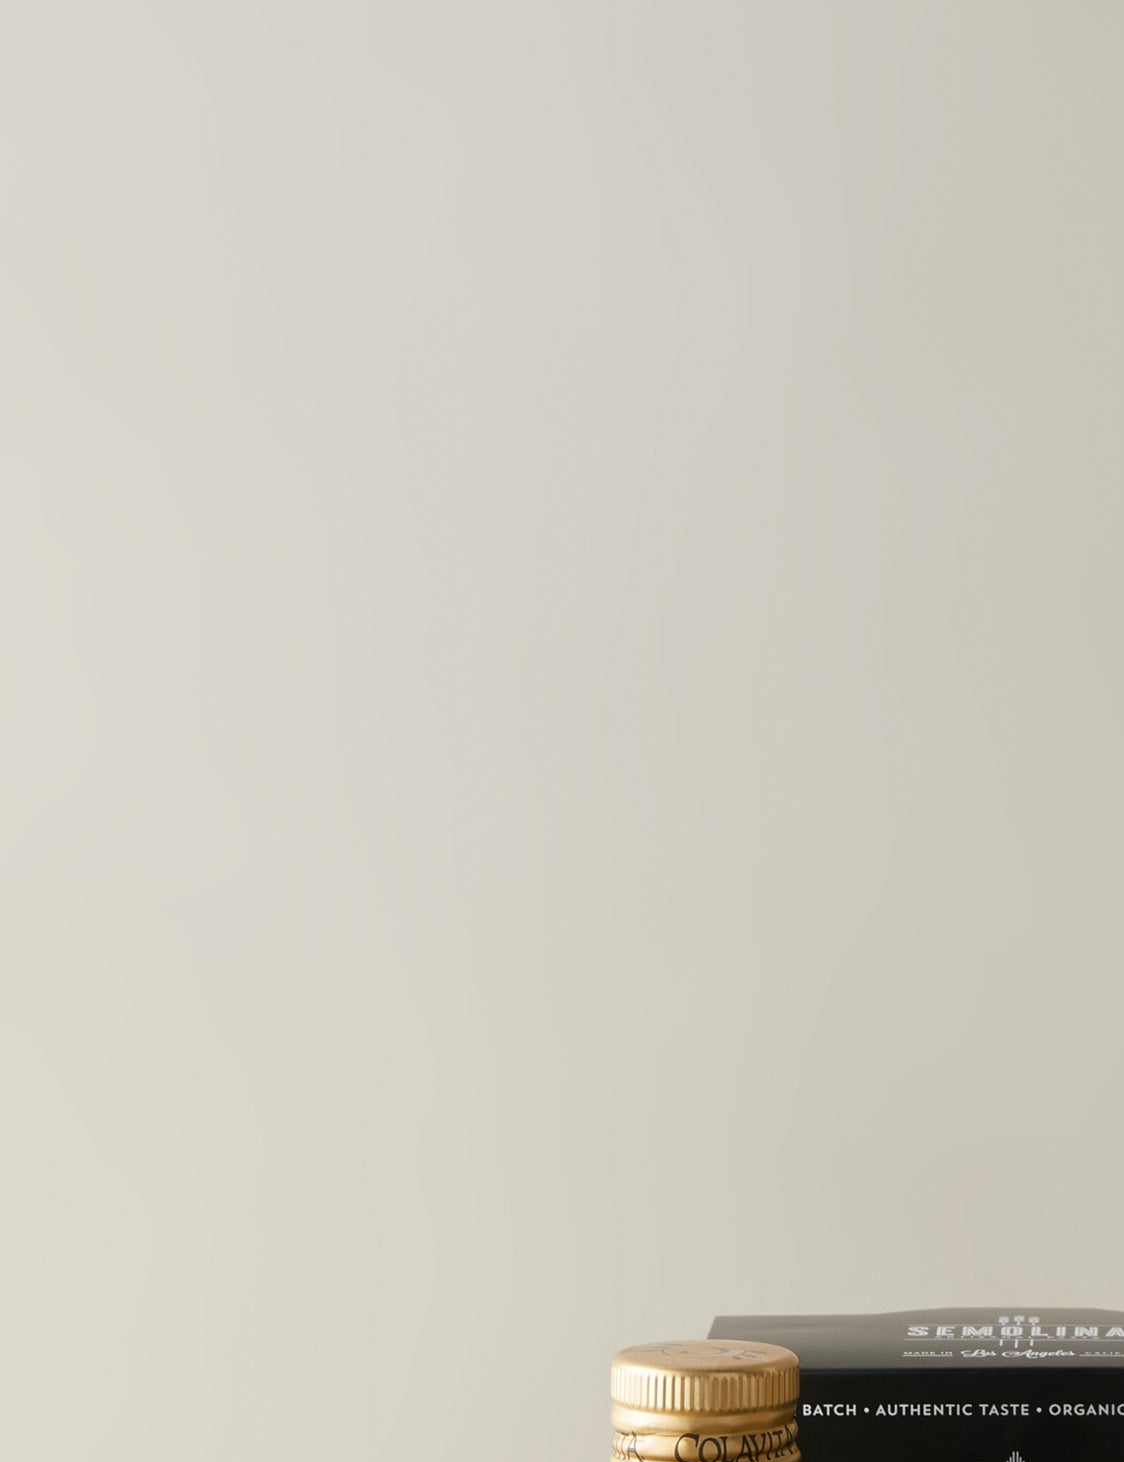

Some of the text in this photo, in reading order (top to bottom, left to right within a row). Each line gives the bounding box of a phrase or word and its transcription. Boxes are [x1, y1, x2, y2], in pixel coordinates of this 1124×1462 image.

[1001, 1349, 1075, 1359] Angeles
[802, 1404, 857, 1416] BATCH
[875, 1404, 973, 1416] AUTHENTIC
[979, 1404, 1030, 1416] TASTE
